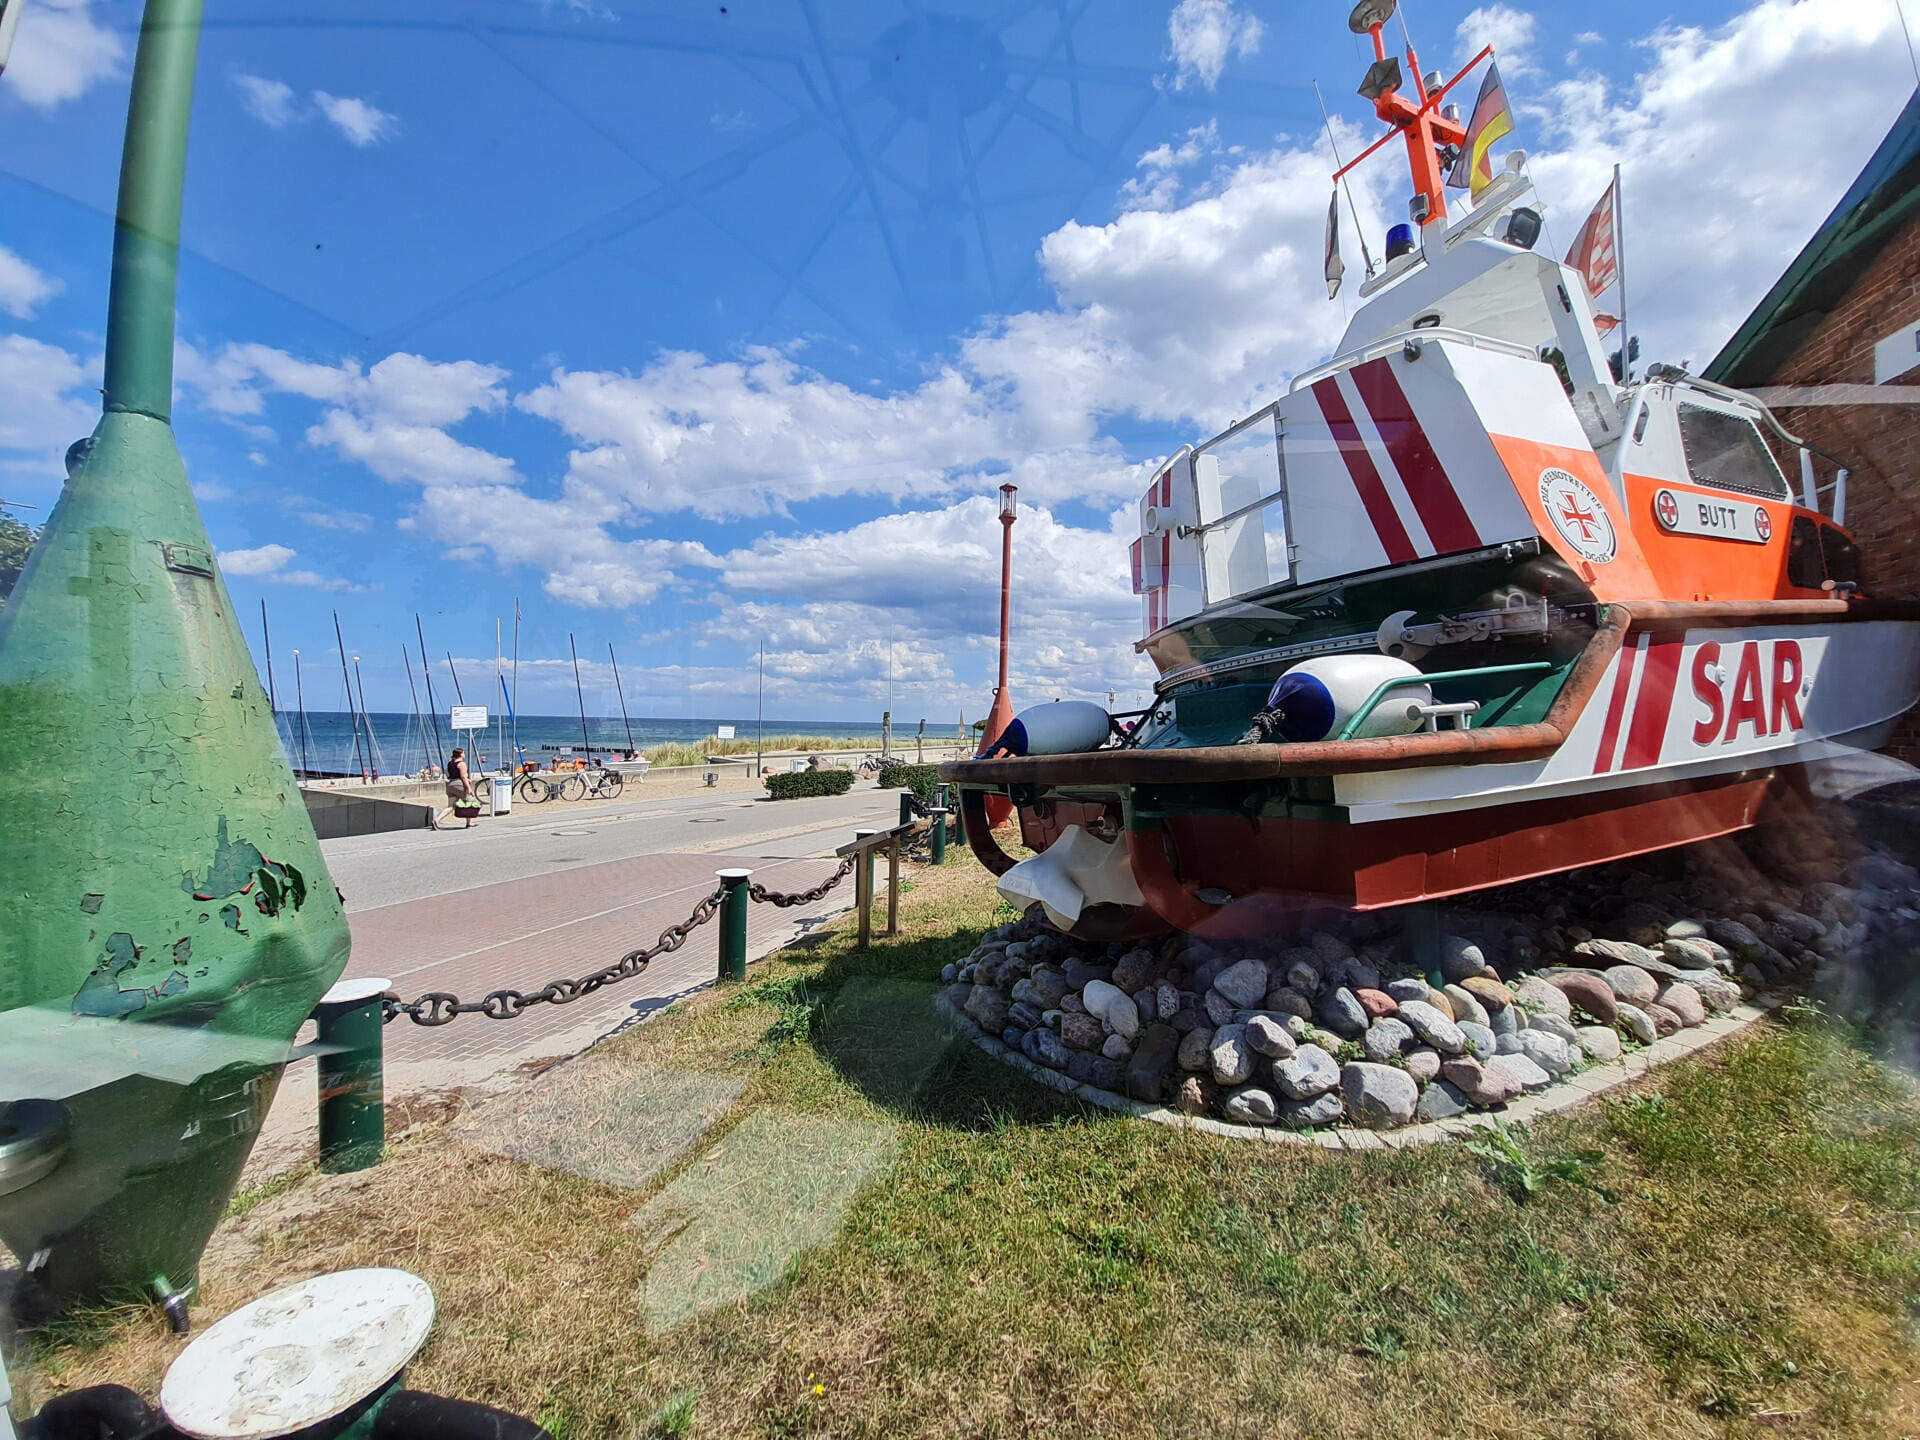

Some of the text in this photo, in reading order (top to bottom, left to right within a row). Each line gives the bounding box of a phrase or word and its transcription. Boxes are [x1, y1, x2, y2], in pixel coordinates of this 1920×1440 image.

[1541, 485, 1550, 504] DIE
[1698, 503, 1736, 530] BUTT
[1691, 640, 1804, 747] SAR
